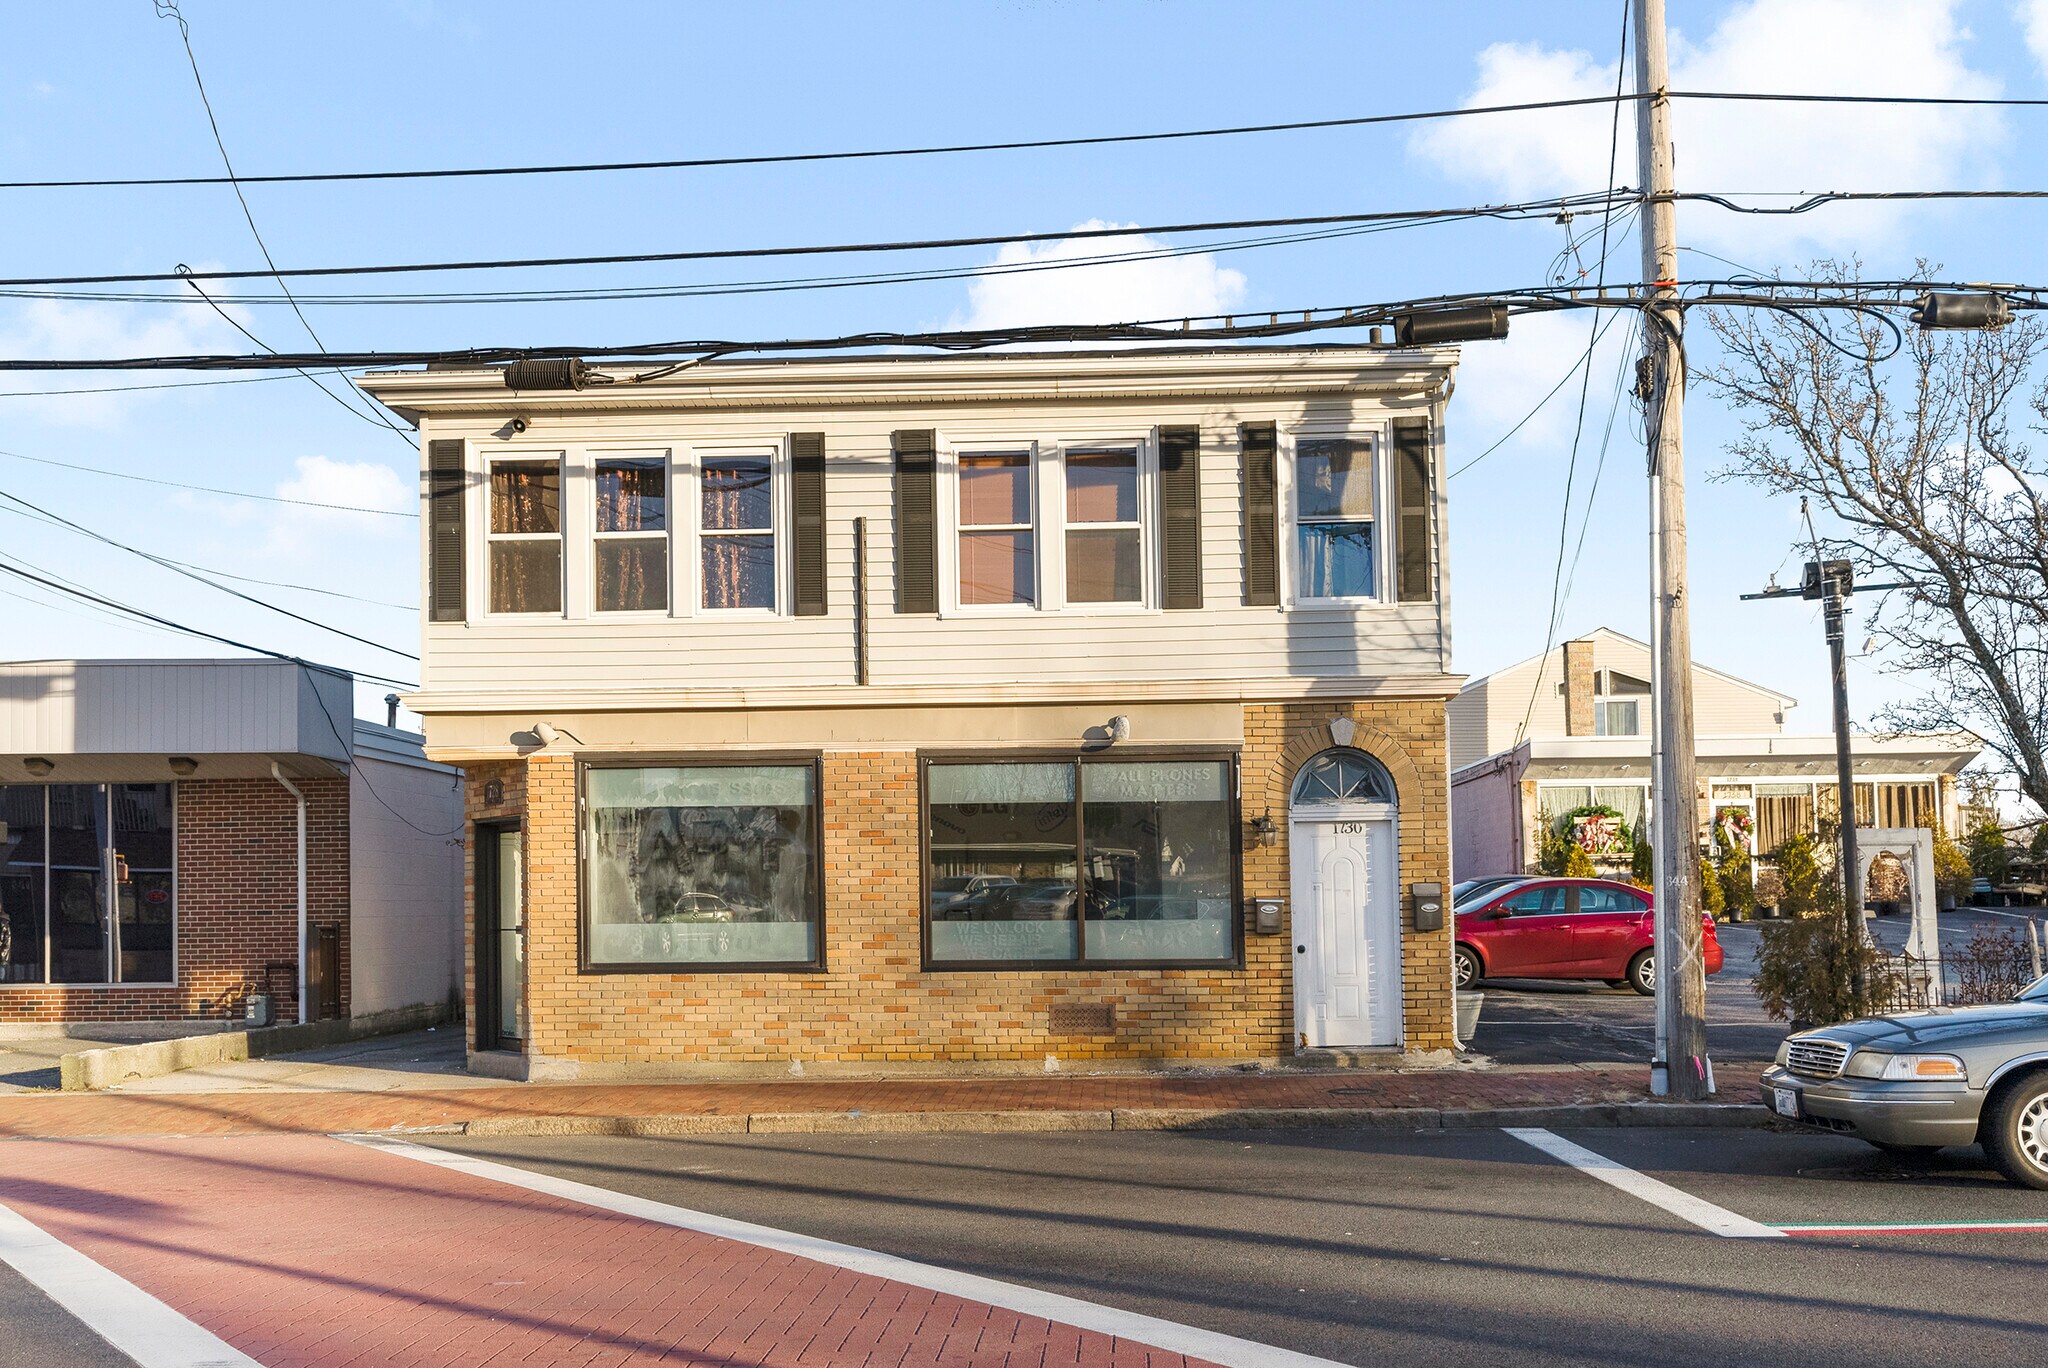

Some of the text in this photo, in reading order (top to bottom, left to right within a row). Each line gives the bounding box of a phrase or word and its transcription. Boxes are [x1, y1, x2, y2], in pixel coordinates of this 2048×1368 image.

[1116, 767, 1212, 783] ALL PHONES
[1118, 783, 1198, 798] MATTER
[1333, 820, 1363, 835] 1730
[1666, 875, 1688, 887] 344
[956, 921, 980, 935] WE
